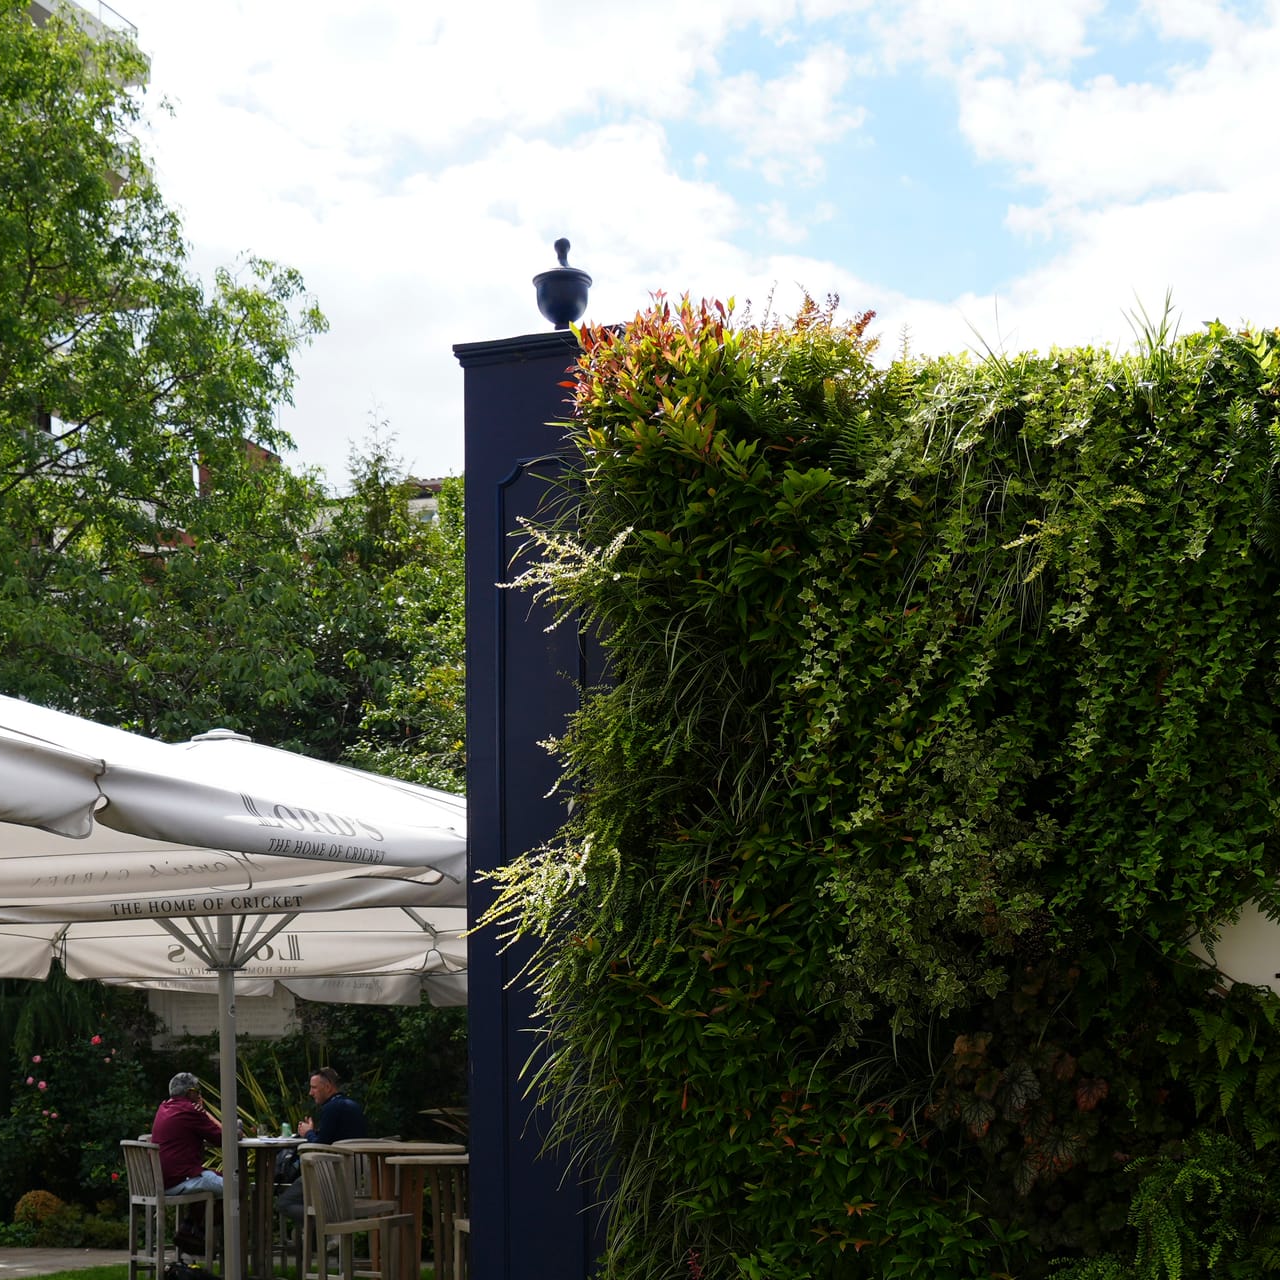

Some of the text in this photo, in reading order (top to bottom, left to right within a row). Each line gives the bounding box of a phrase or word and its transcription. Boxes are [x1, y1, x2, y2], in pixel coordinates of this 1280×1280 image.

[239, 792, 384, 841] LORD'S
[268, 838, 386, 863] THE HOME OF CRICKET
[110, 895, 304, 916] THE HOME OF CRICKET
